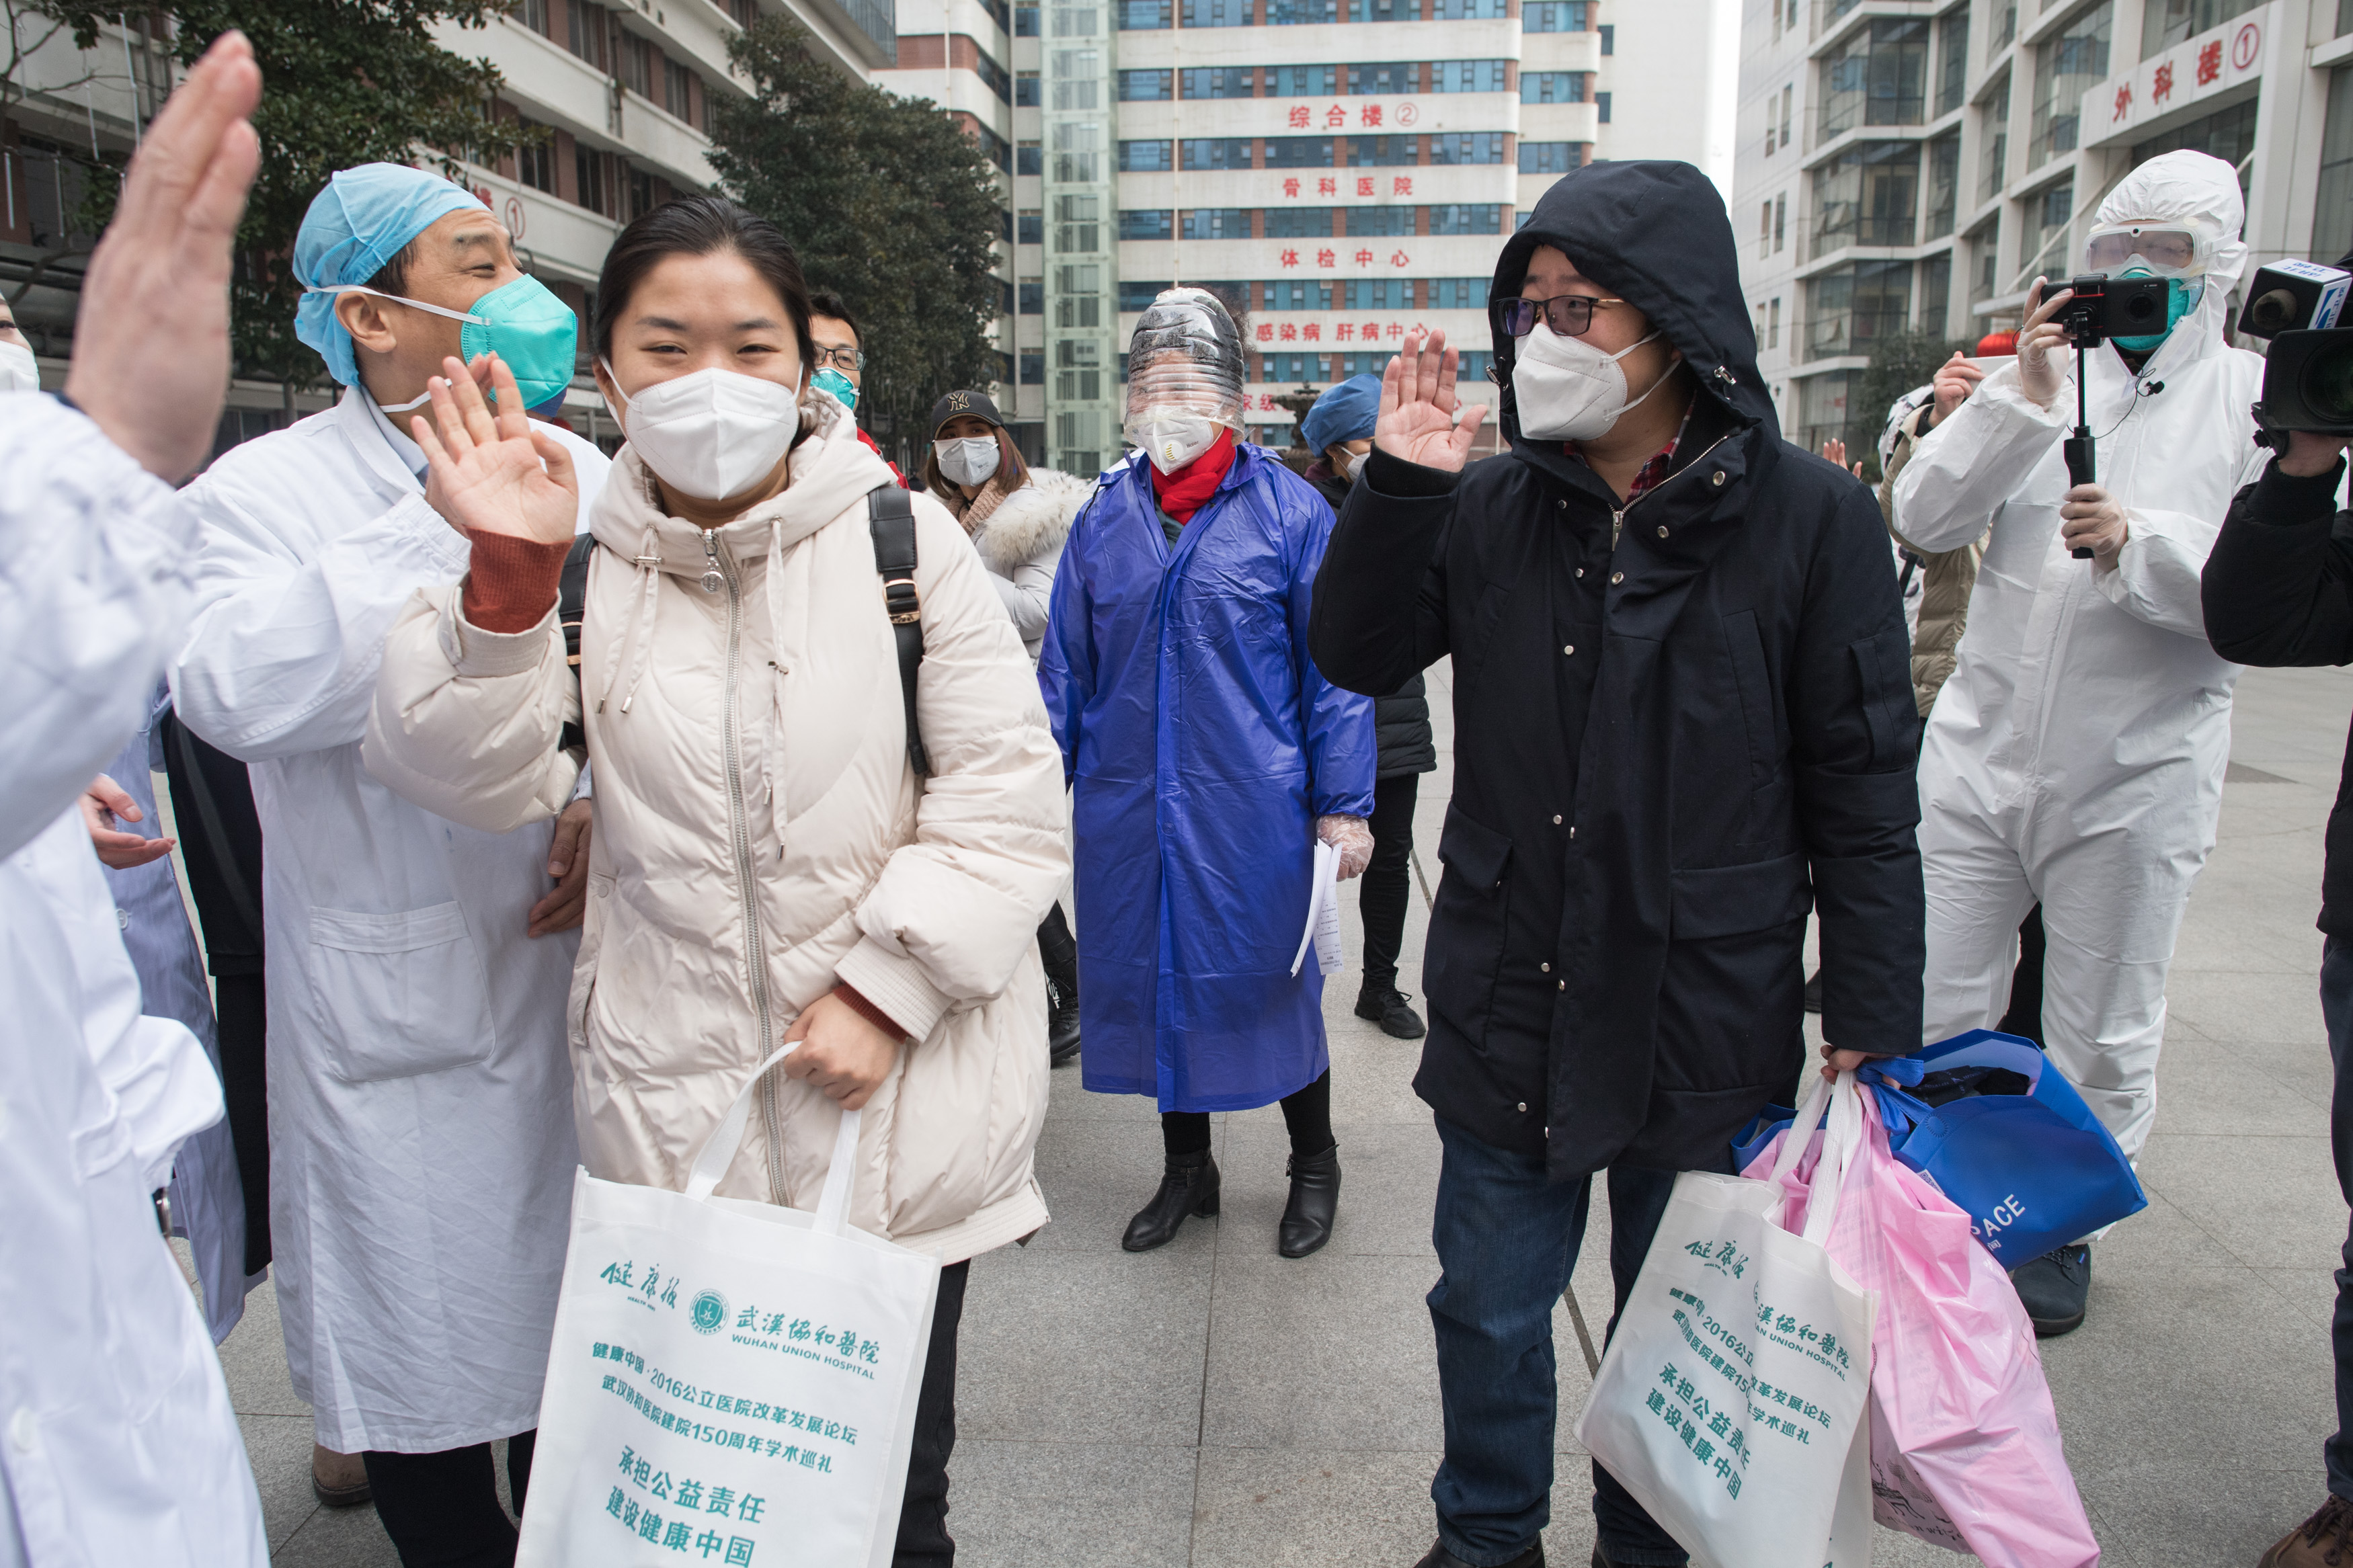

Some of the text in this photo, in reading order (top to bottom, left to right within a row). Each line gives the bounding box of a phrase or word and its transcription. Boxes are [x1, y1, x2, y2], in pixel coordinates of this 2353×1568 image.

[2112, 23, 2260, 123] 外科楼①
[1289, 102, 1419, 128] 综合楼②
[1283, 177, 1414, 198] 骨科医院
[1281, 248, 1410, 268] 体检中心
[947, 393, 970, 412] NY
[732, 1333, 875, 1380] WUHAN UNION HOSPITAL
[1756, 1303, 1849, 1369] 漢協和醫院
[1769, 1333, 1803, 1353] UNION
[1806, 1350, 1846, 1382] HOSPITAL
[602, 1374, 832, 1473] 武汉协和医院建院150周年学术巡礼
[1646, 1387, 1742, 1501] 建设健康中国
[1659, 1362, 1751, 1470] 承担公益责任
[619, 1445, 766, 1524] 承担公益责任
[606, 1485, 755, 1568] 建设健康中国
